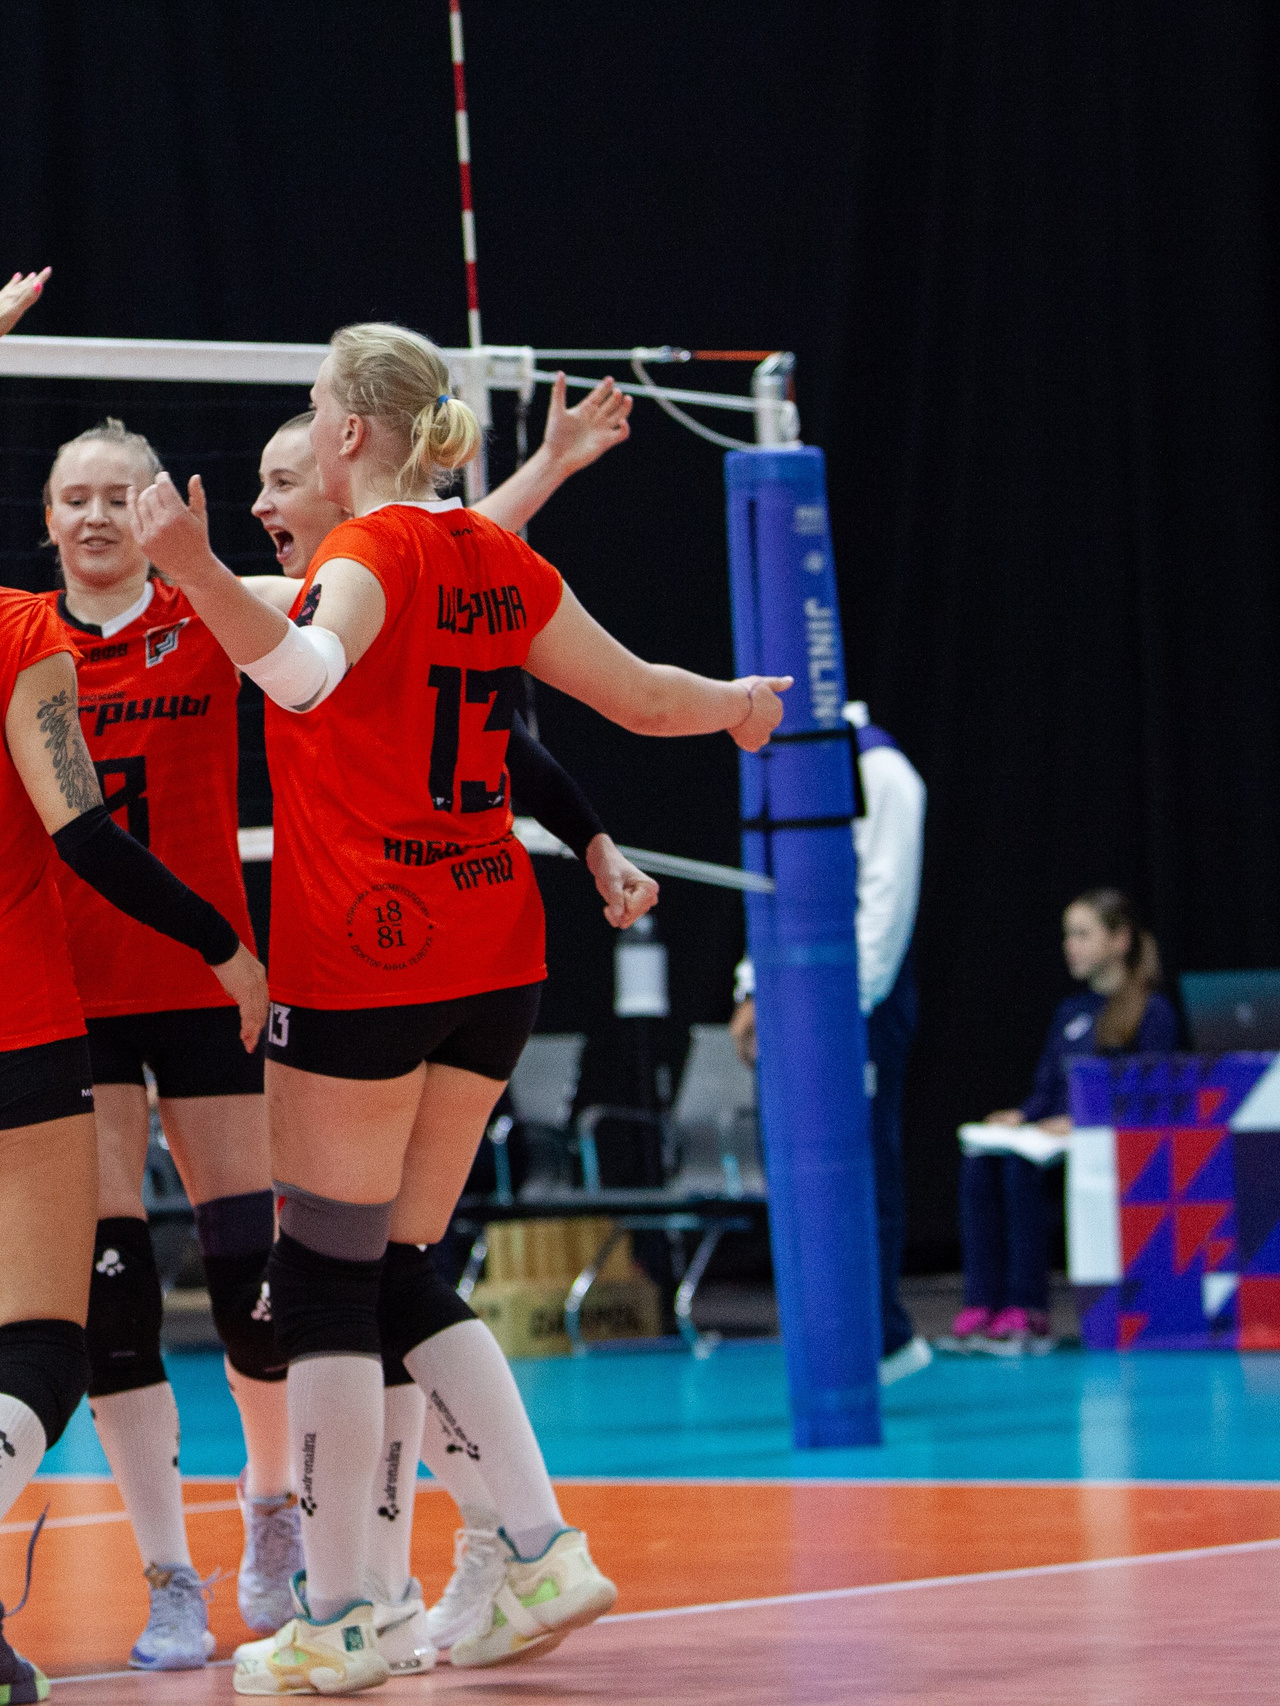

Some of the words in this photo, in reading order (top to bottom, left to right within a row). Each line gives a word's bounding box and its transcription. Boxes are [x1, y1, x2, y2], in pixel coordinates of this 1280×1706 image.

[77, 694, 211, 737] грицы
[428, 663, 526, 815] 13
[451, 849, 514, 891] КРАЙ
[373, 899, 403, 924] 18
[376, 925, 407, 949] 81
